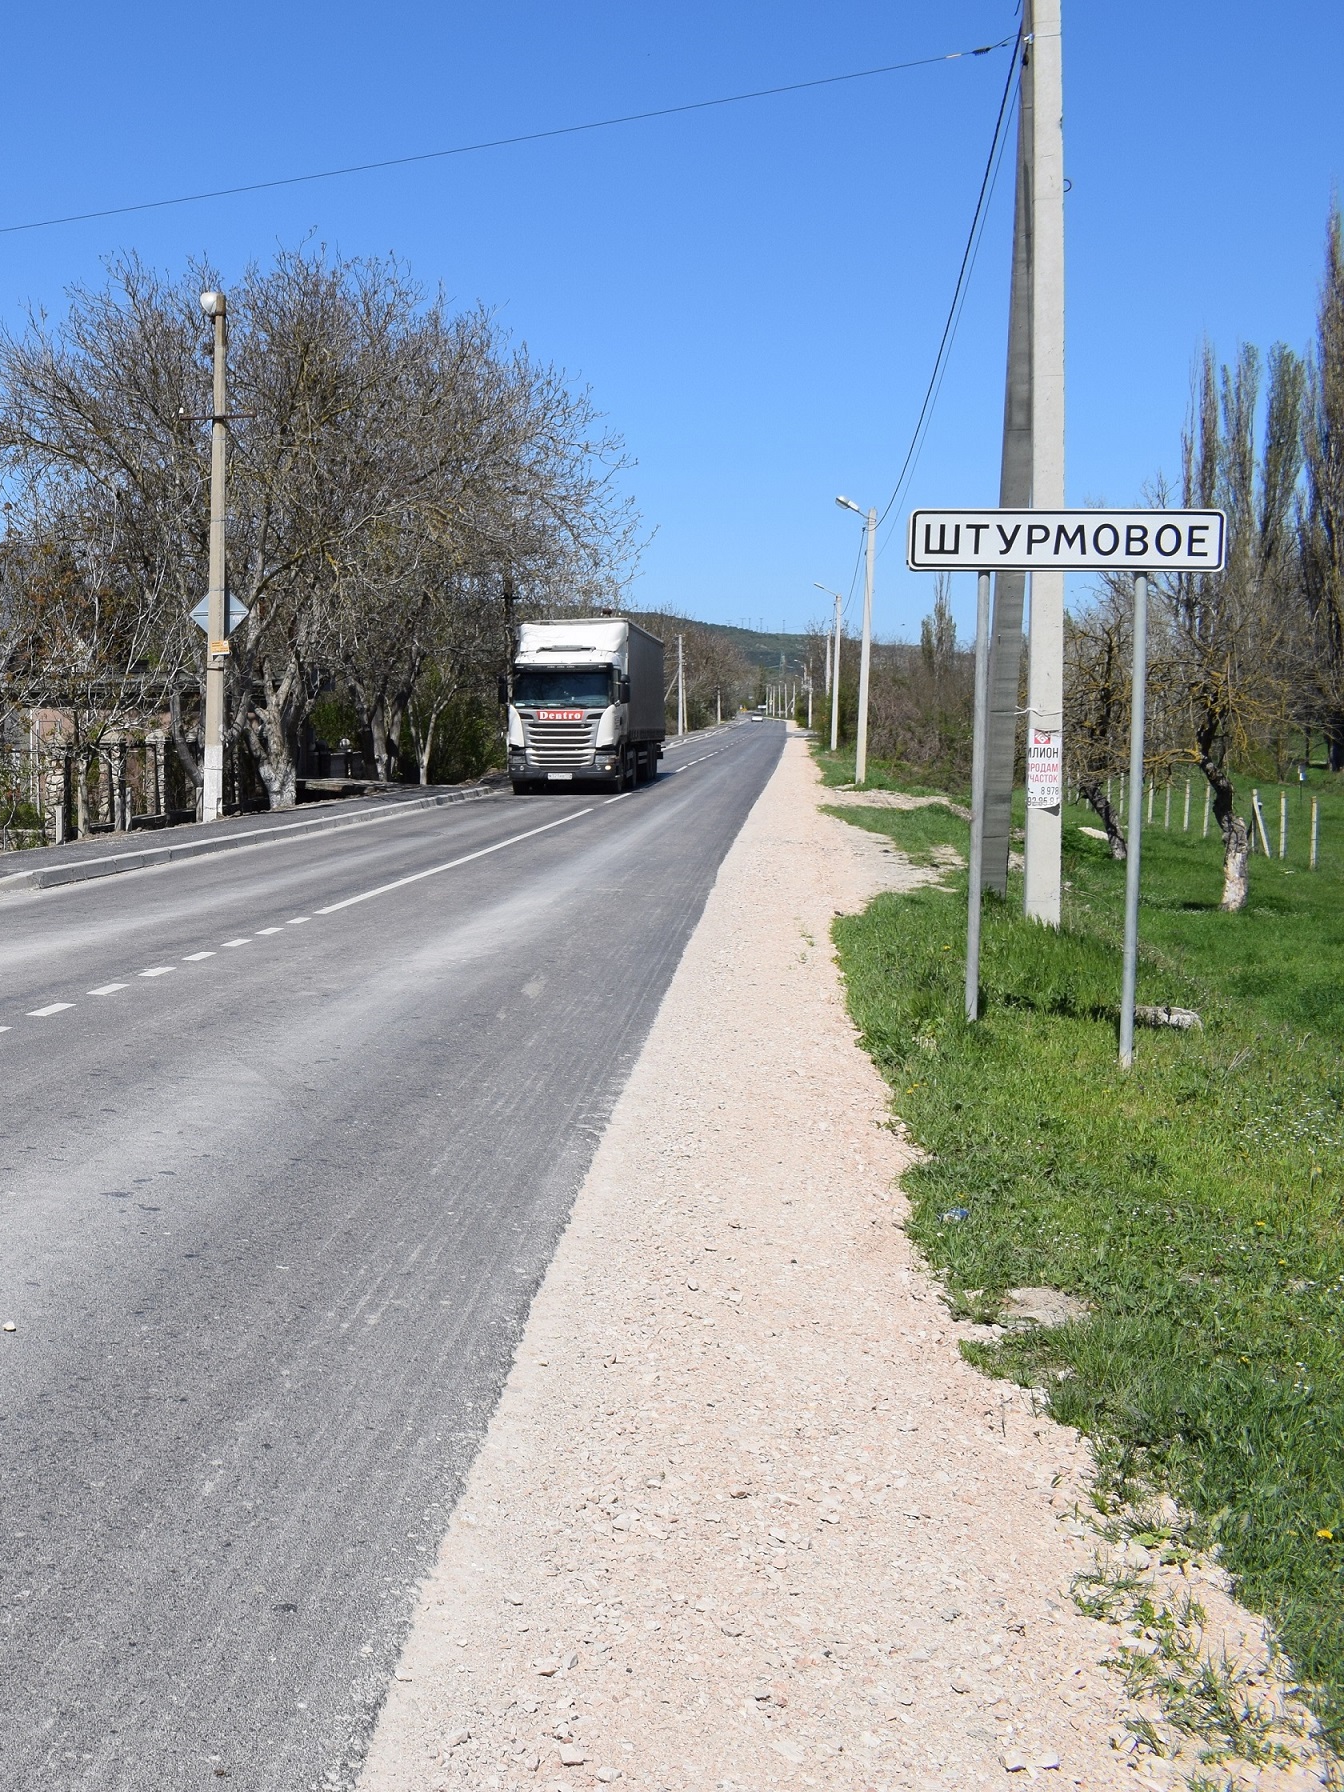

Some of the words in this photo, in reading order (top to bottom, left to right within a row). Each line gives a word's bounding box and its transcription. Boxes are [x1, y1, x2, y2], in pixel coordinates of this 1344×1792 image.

[924, 523, 1209, 556] ШТУРМОВОЕ
[539, 711, 581, 720] Dentro
[1028, 774, 1058, 783] ЧАСТОК
